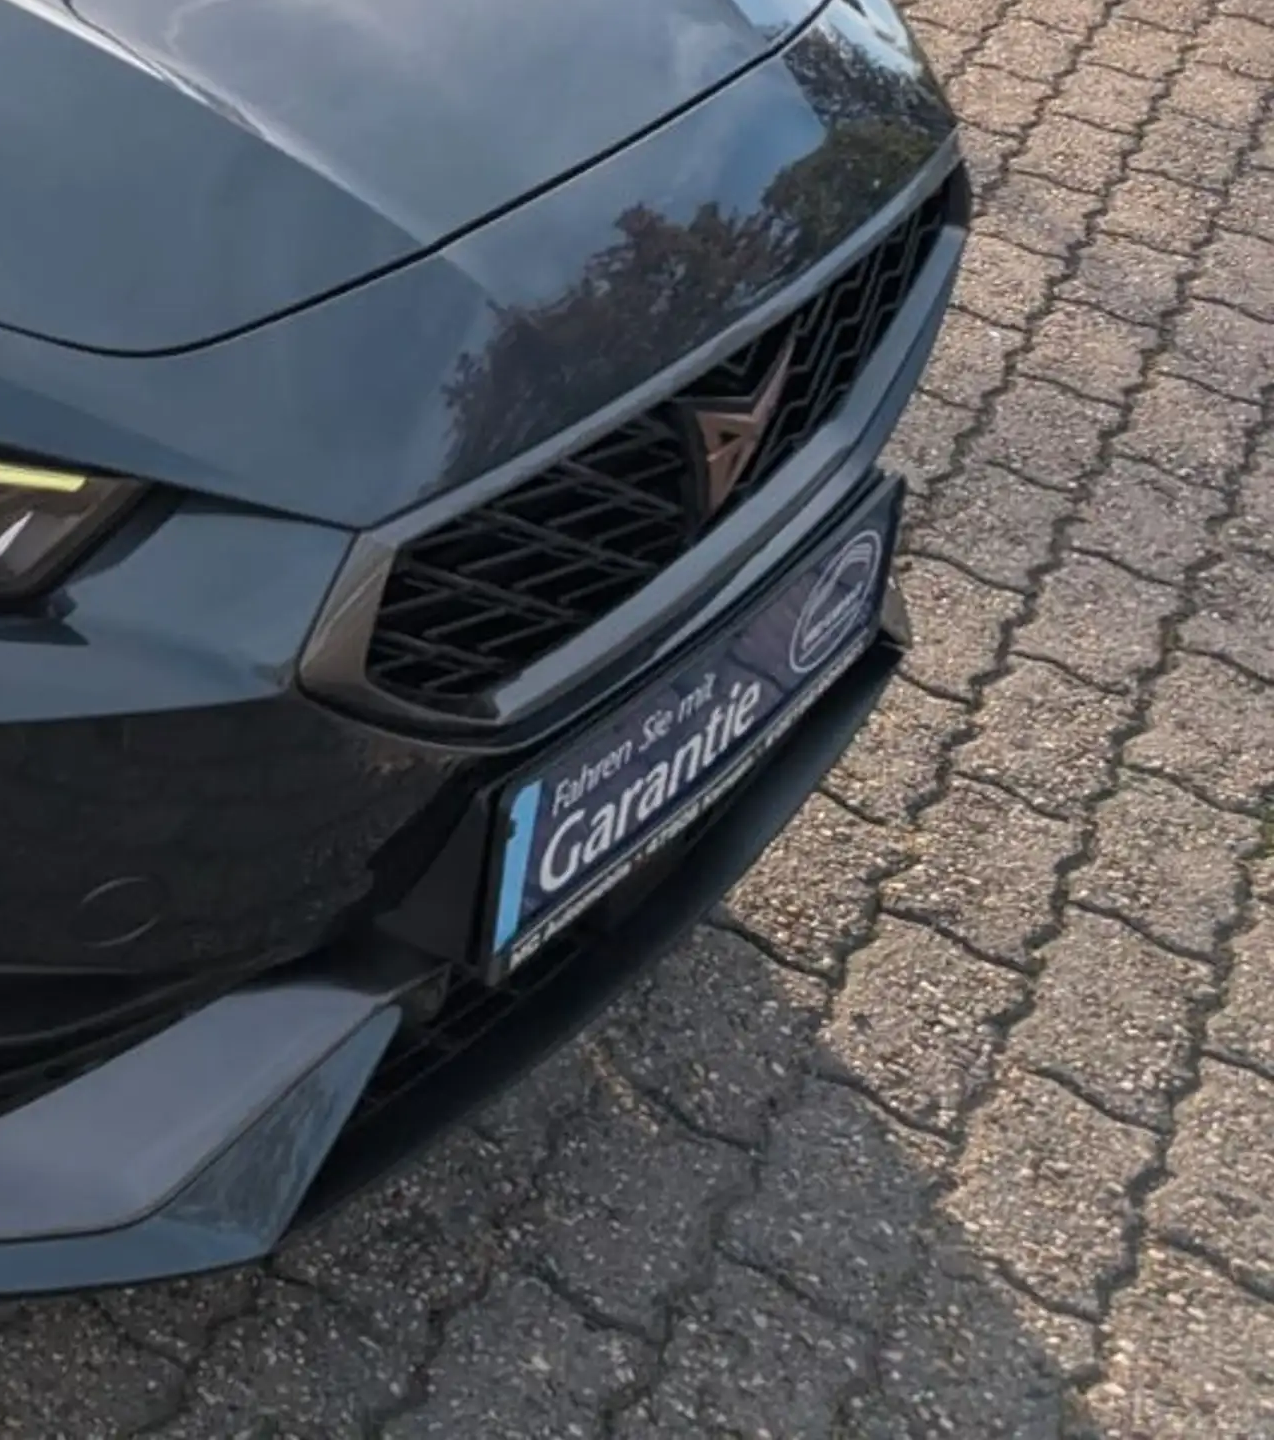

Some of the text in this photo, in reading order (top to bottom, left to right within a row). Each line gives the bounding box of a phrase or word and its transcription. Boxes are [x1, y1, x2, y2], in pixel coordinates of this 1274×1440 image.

[539, 680, 761, 893] Garantie
[553, 739, 633, 817] Fahren
[638, 710, 673, 753] Sie
[677, 672, 716, 723] mit
